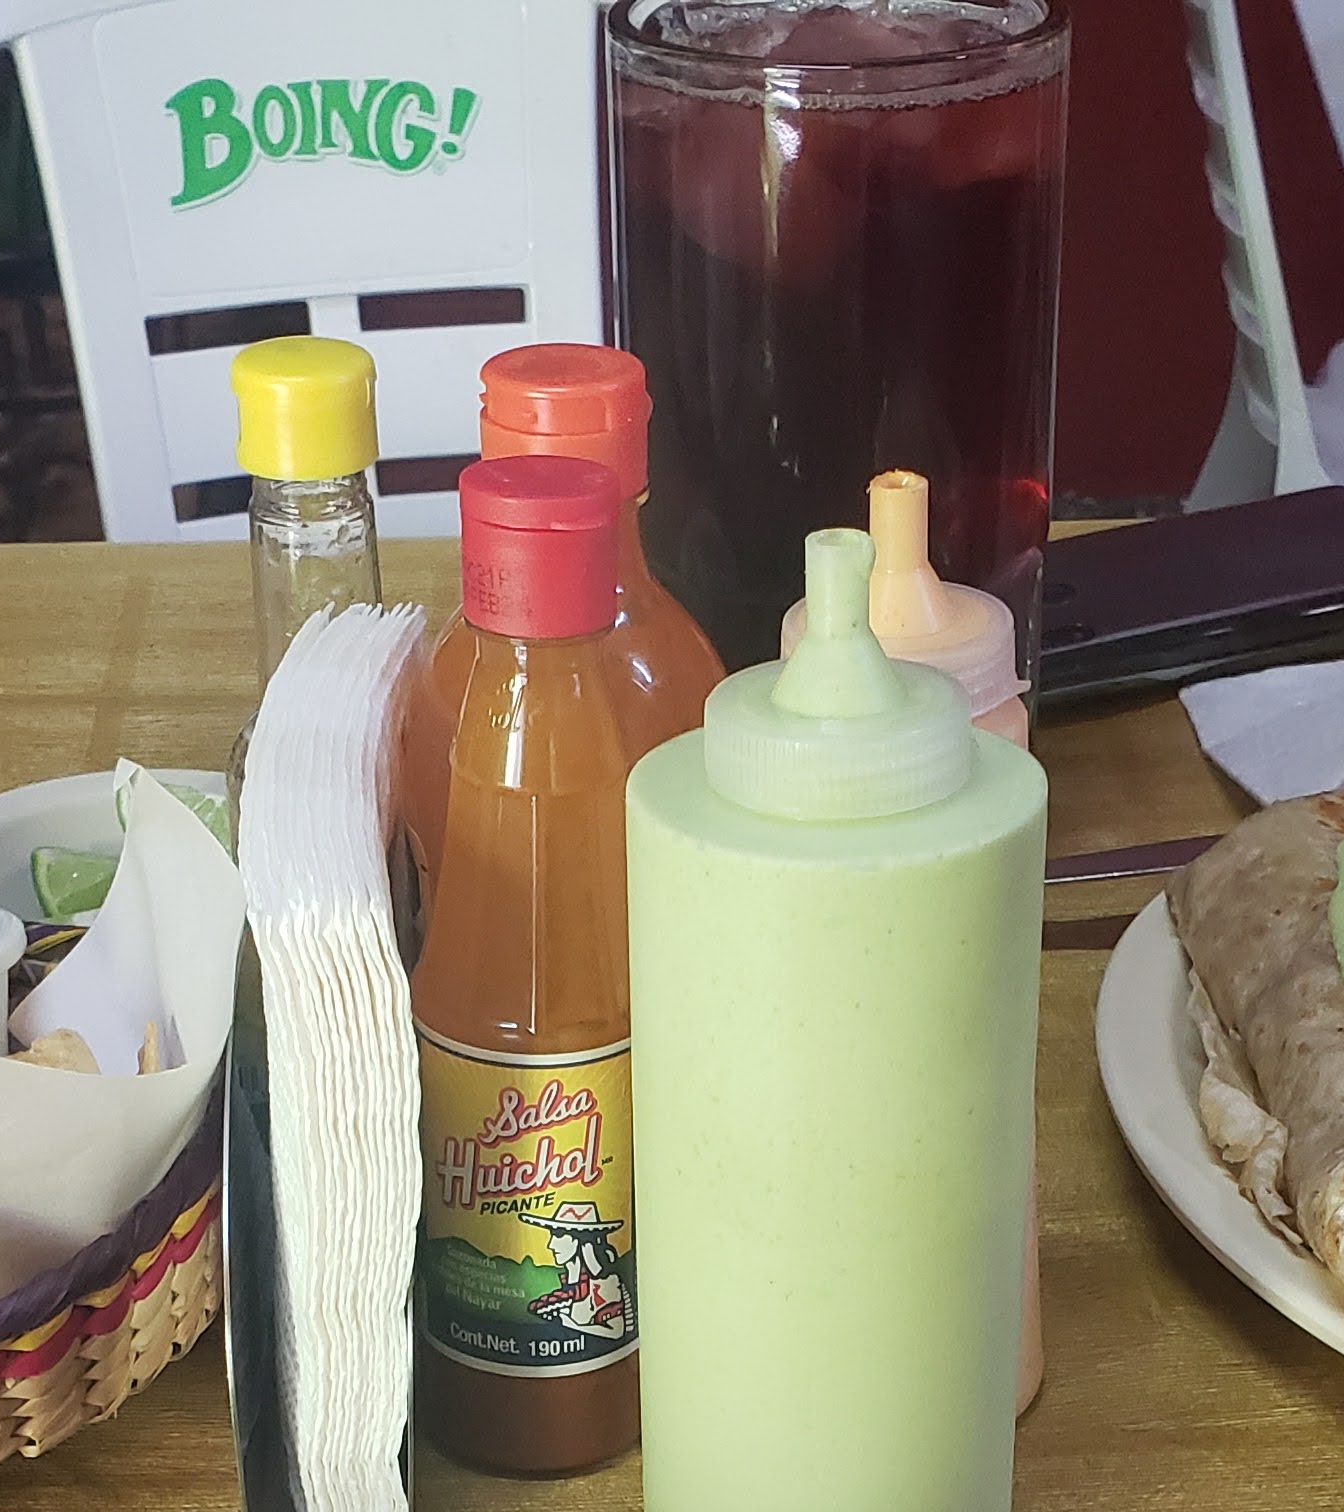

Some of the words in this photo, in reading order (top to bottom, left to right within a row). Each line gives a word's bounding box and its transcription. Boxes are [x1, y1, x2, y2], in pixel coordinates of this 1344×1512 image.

[165, 78, 478, 206] BOING!
[479, 1080, 594, 1145] Salsa
[436, 1114, 601, 1206] Huichol
[479, 1192, 556, 1216] PICANTE
[528, 1340, 561, 1357] 190
[563, 1334, 585, 1354] ml
